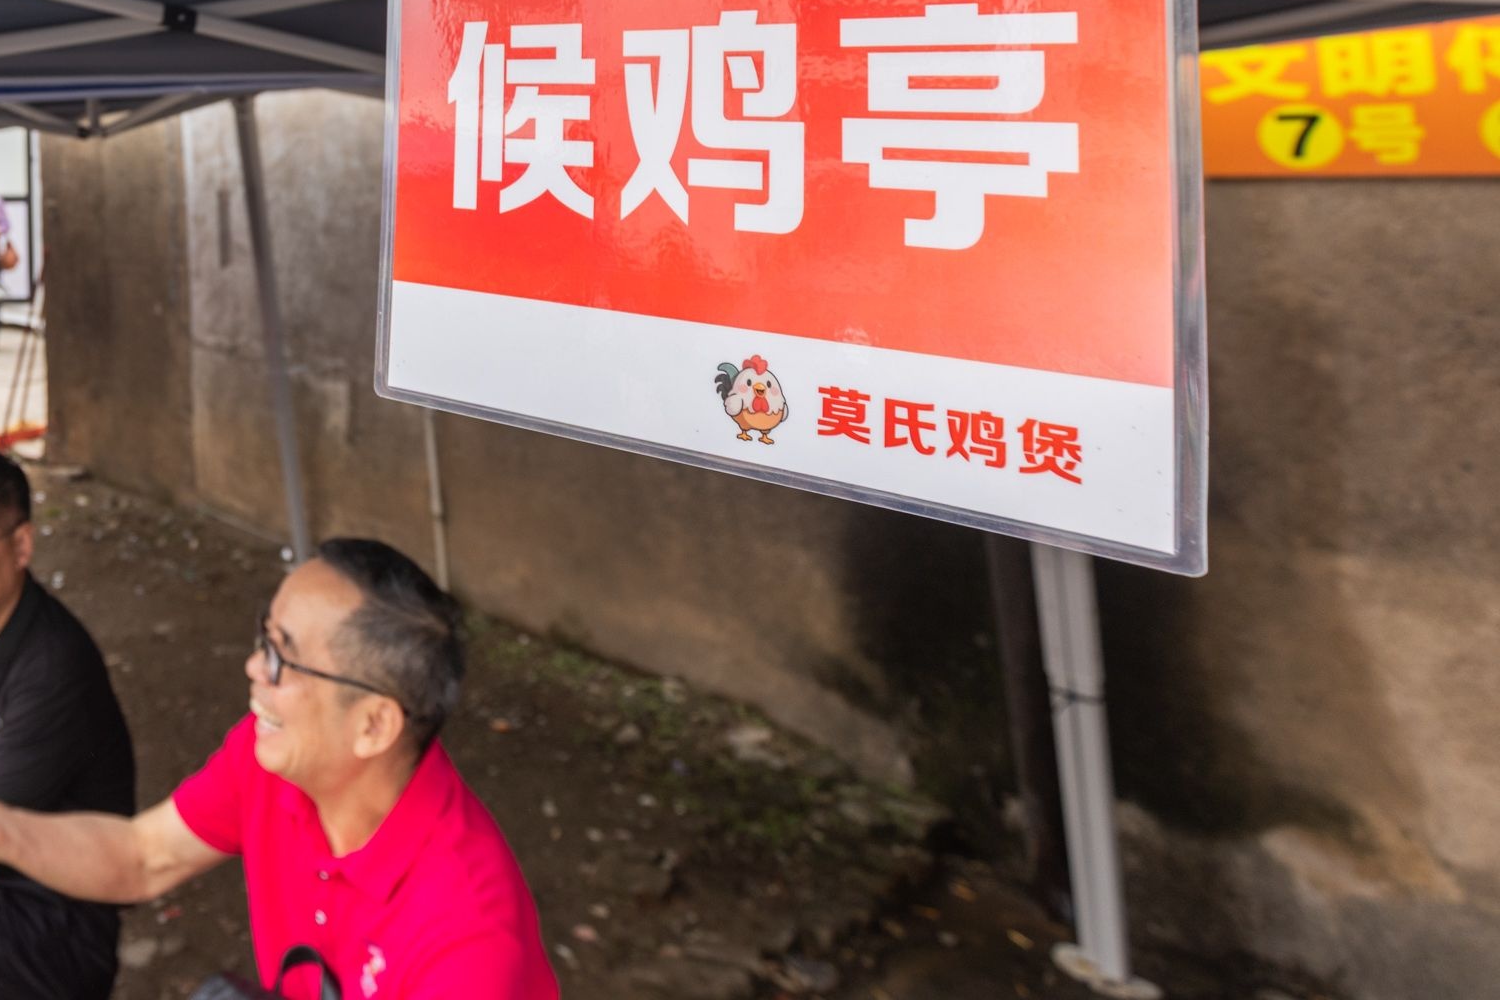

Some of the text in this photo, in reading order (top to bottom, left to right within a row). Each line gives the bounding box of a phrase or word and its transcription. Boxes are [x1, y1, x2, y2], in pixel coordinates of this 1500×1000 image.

[448, 3, 1079, 249] 候鸡亭
[817, 386, 1082, 485] 莫氏鸡煲
